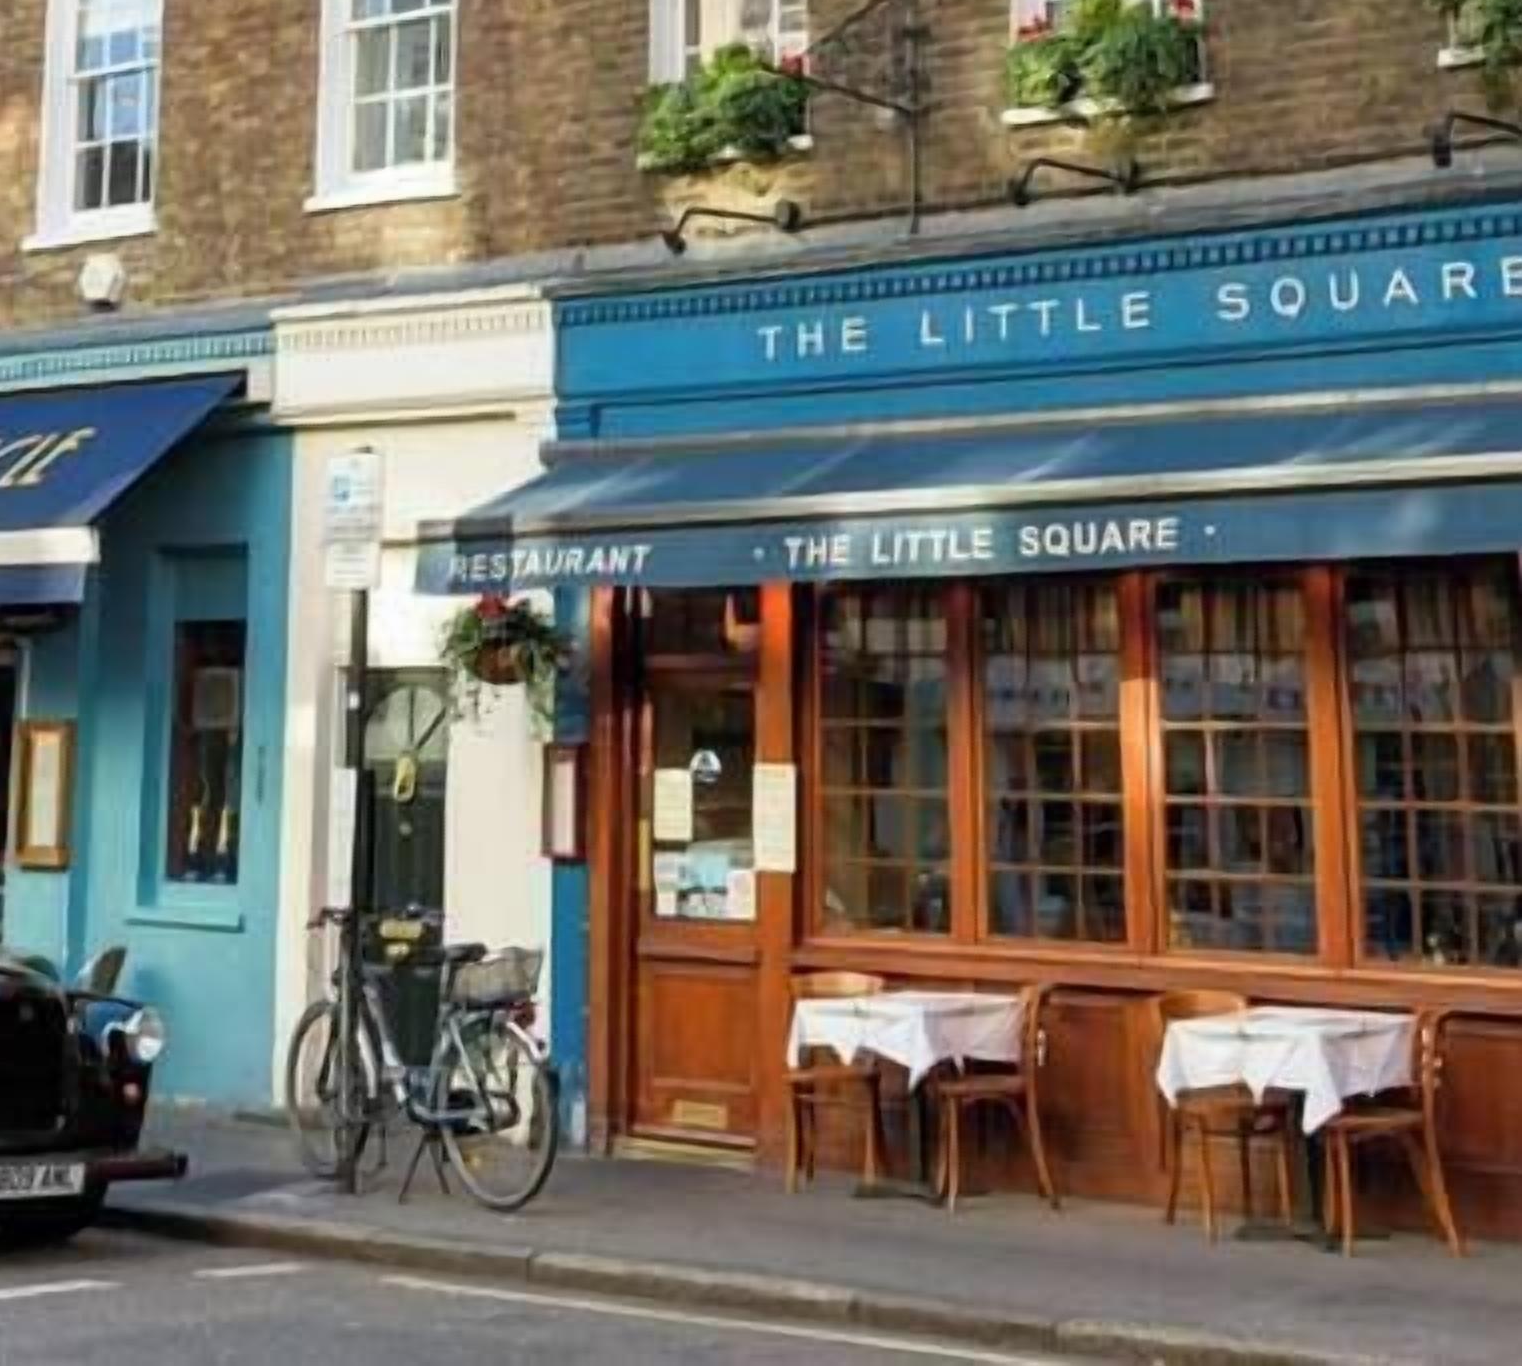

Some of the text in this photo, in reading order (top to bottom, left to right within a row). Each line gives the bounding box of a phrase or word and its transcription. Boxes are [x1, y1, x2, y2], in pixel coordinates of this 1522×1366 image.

[757, 255, 1522, 362] THE LITTLE SQUARE
[446, 543, 654, 582] RESTAURANT
[784, 516, 1180, 570] THE LITTLE SQUARE
